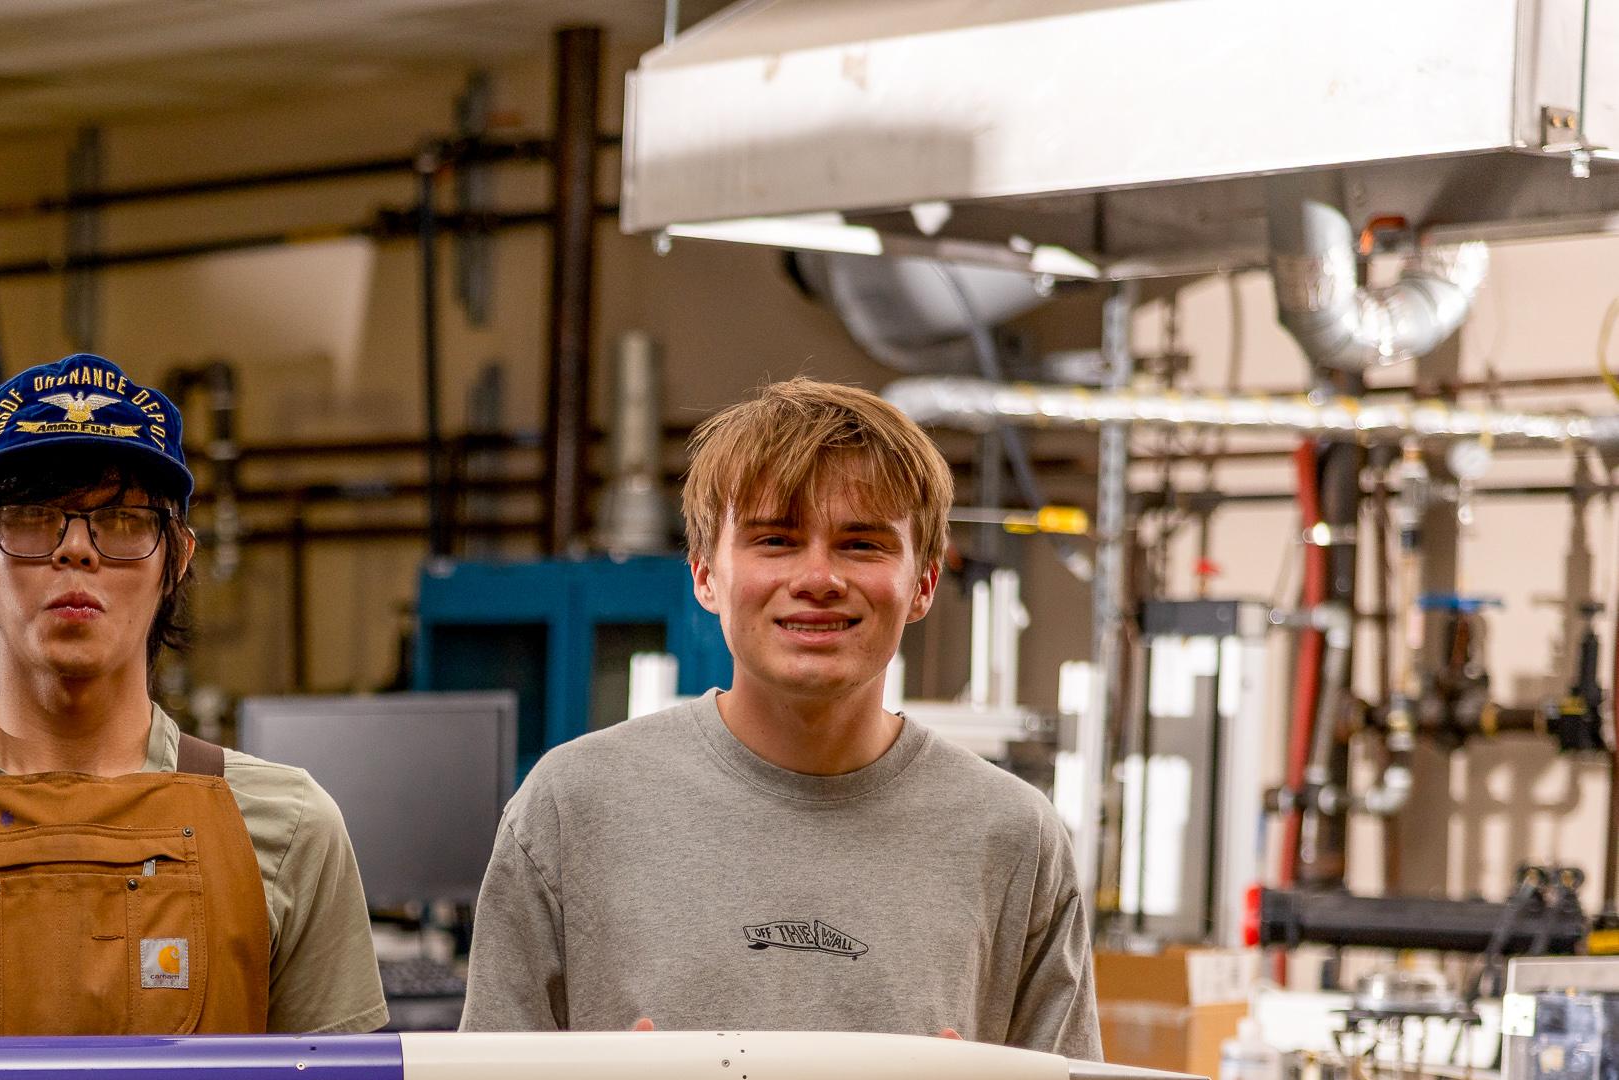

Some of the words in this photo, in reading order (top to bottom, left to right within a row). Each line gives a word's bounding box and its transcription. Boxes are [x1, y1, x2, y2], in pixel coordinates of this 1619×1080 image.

[755, 927, 772, 940] OFF
[775, 924, 814, 945] THE
[822, 927, 853, 951] WALL
